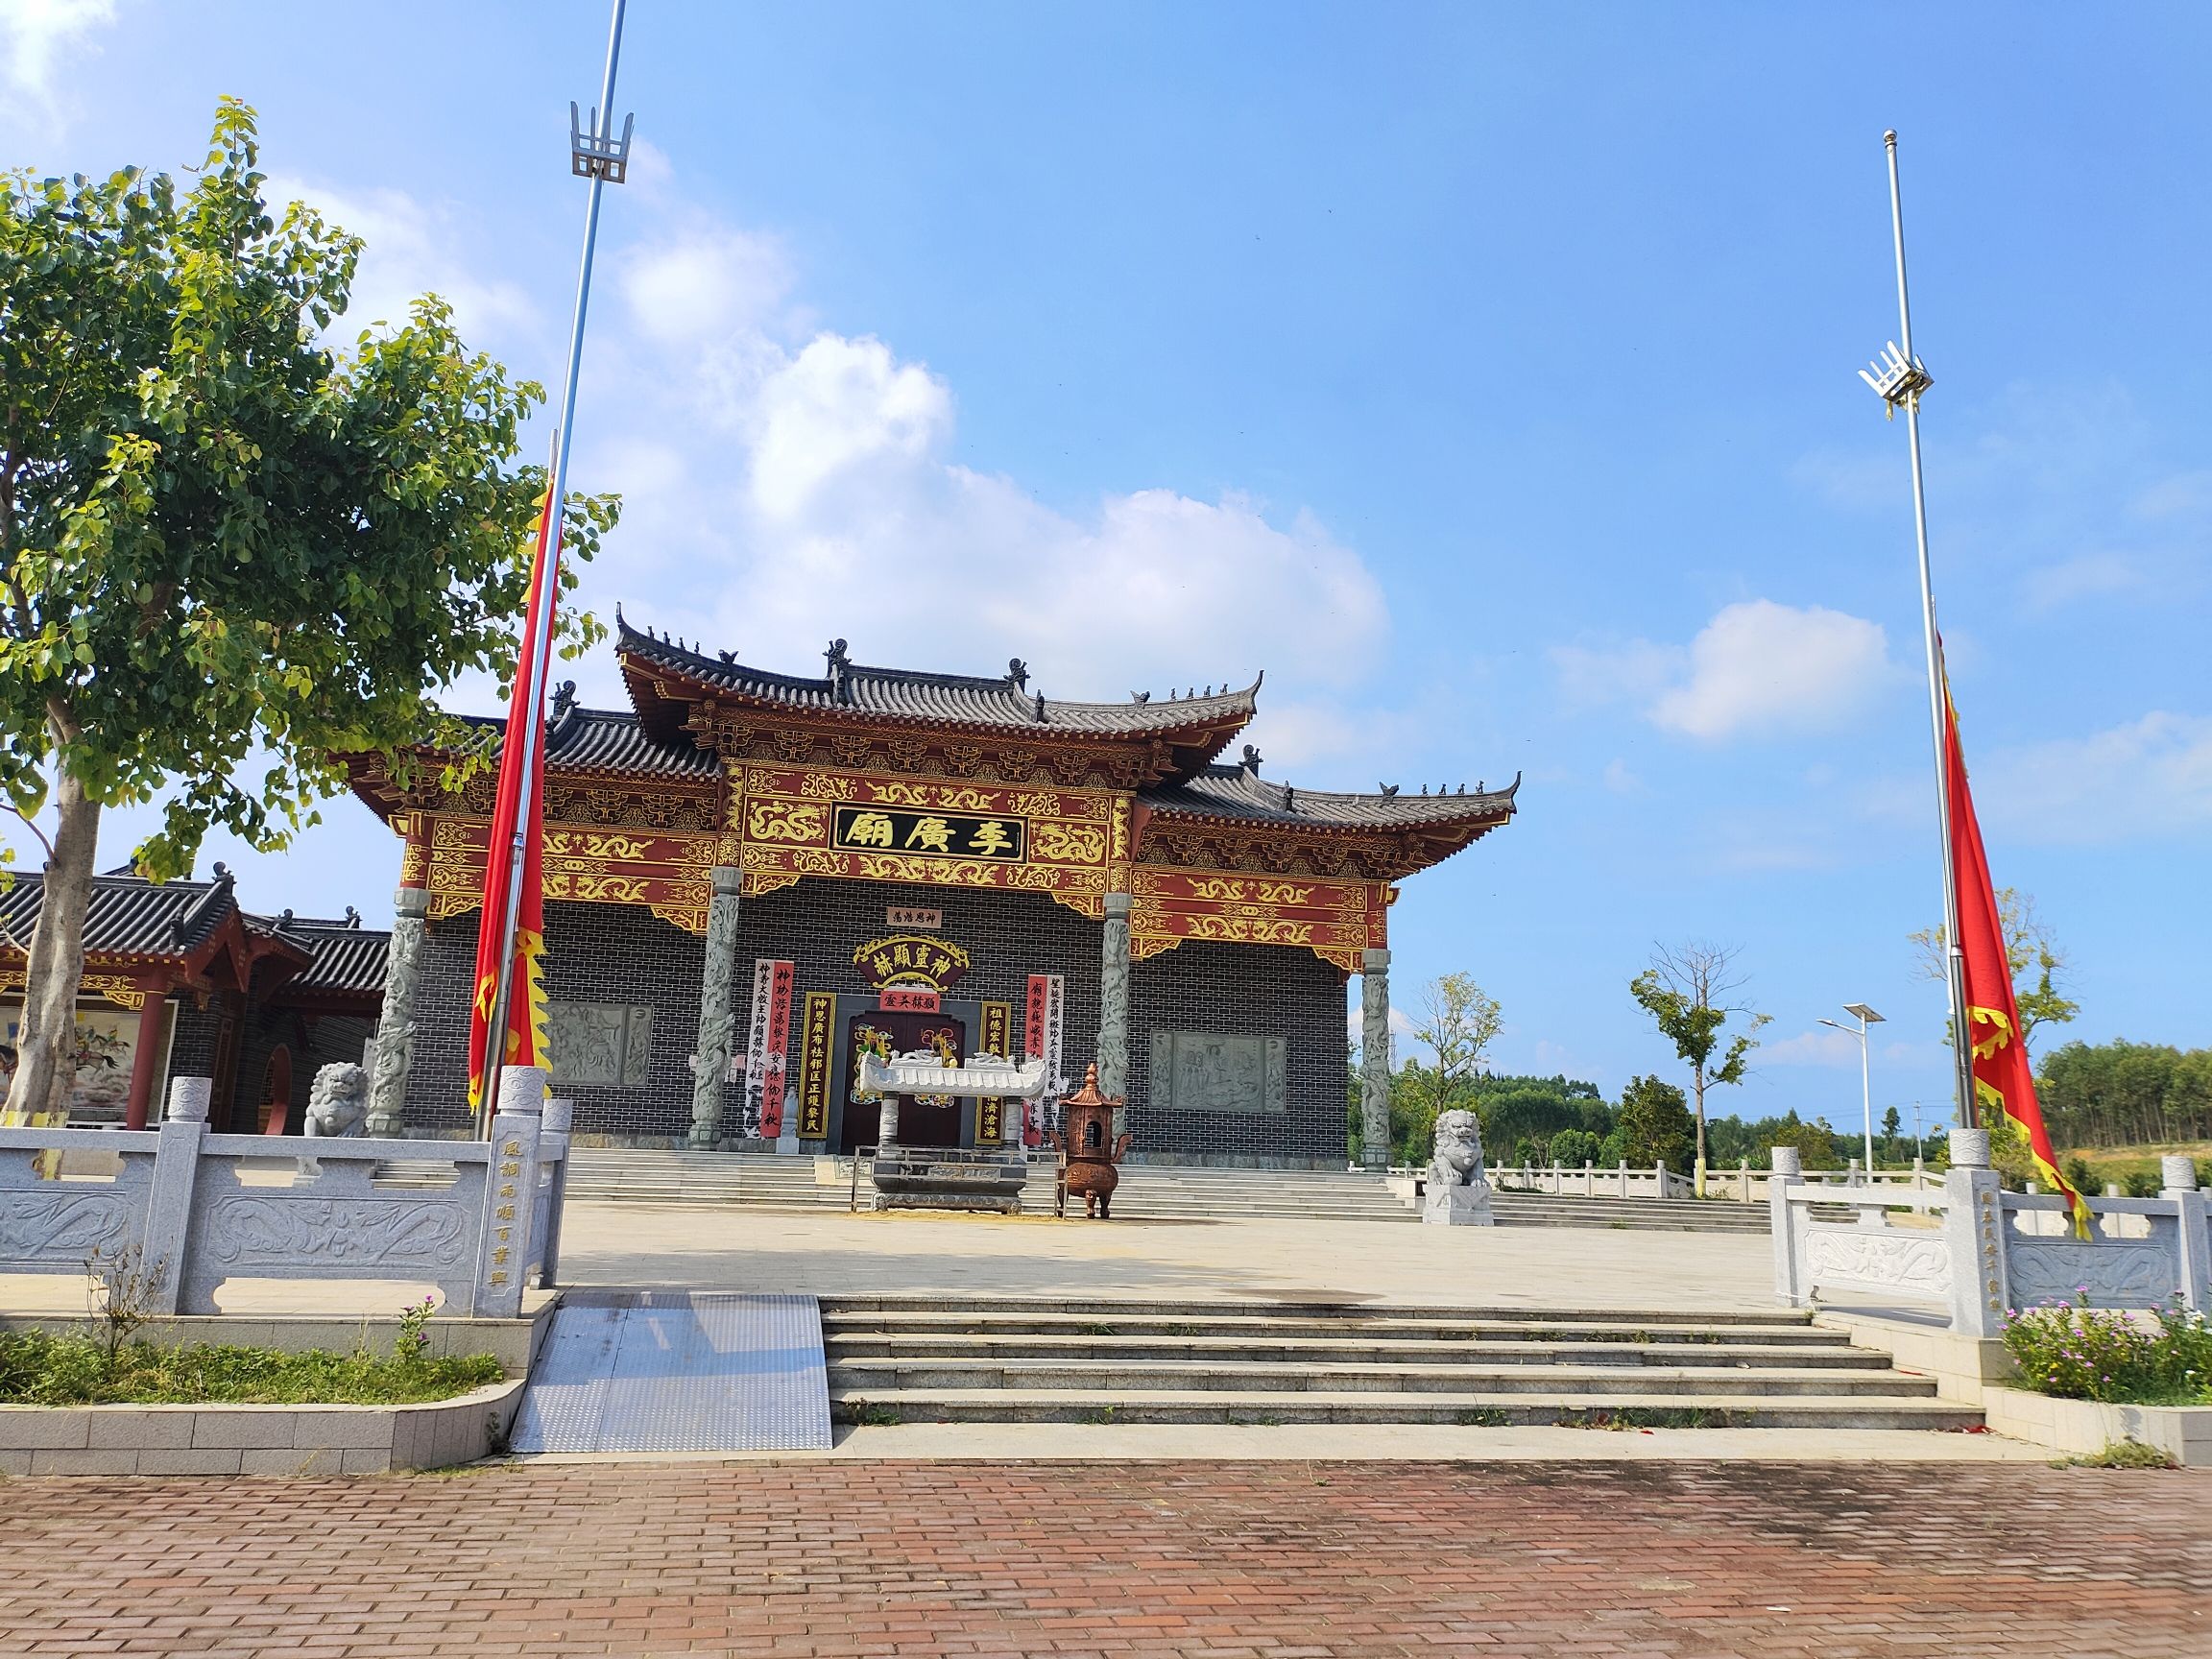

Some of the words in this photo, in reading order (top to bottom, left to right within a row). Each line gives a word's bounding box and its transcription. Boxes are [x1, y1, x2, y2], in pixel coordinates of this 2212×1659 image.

[845, 812, 1013, 855] 李廣廟
[873, 944, 951, 979] 神靈顯赫
[488, 1140, 522, 1286] 風調雨順百業興
